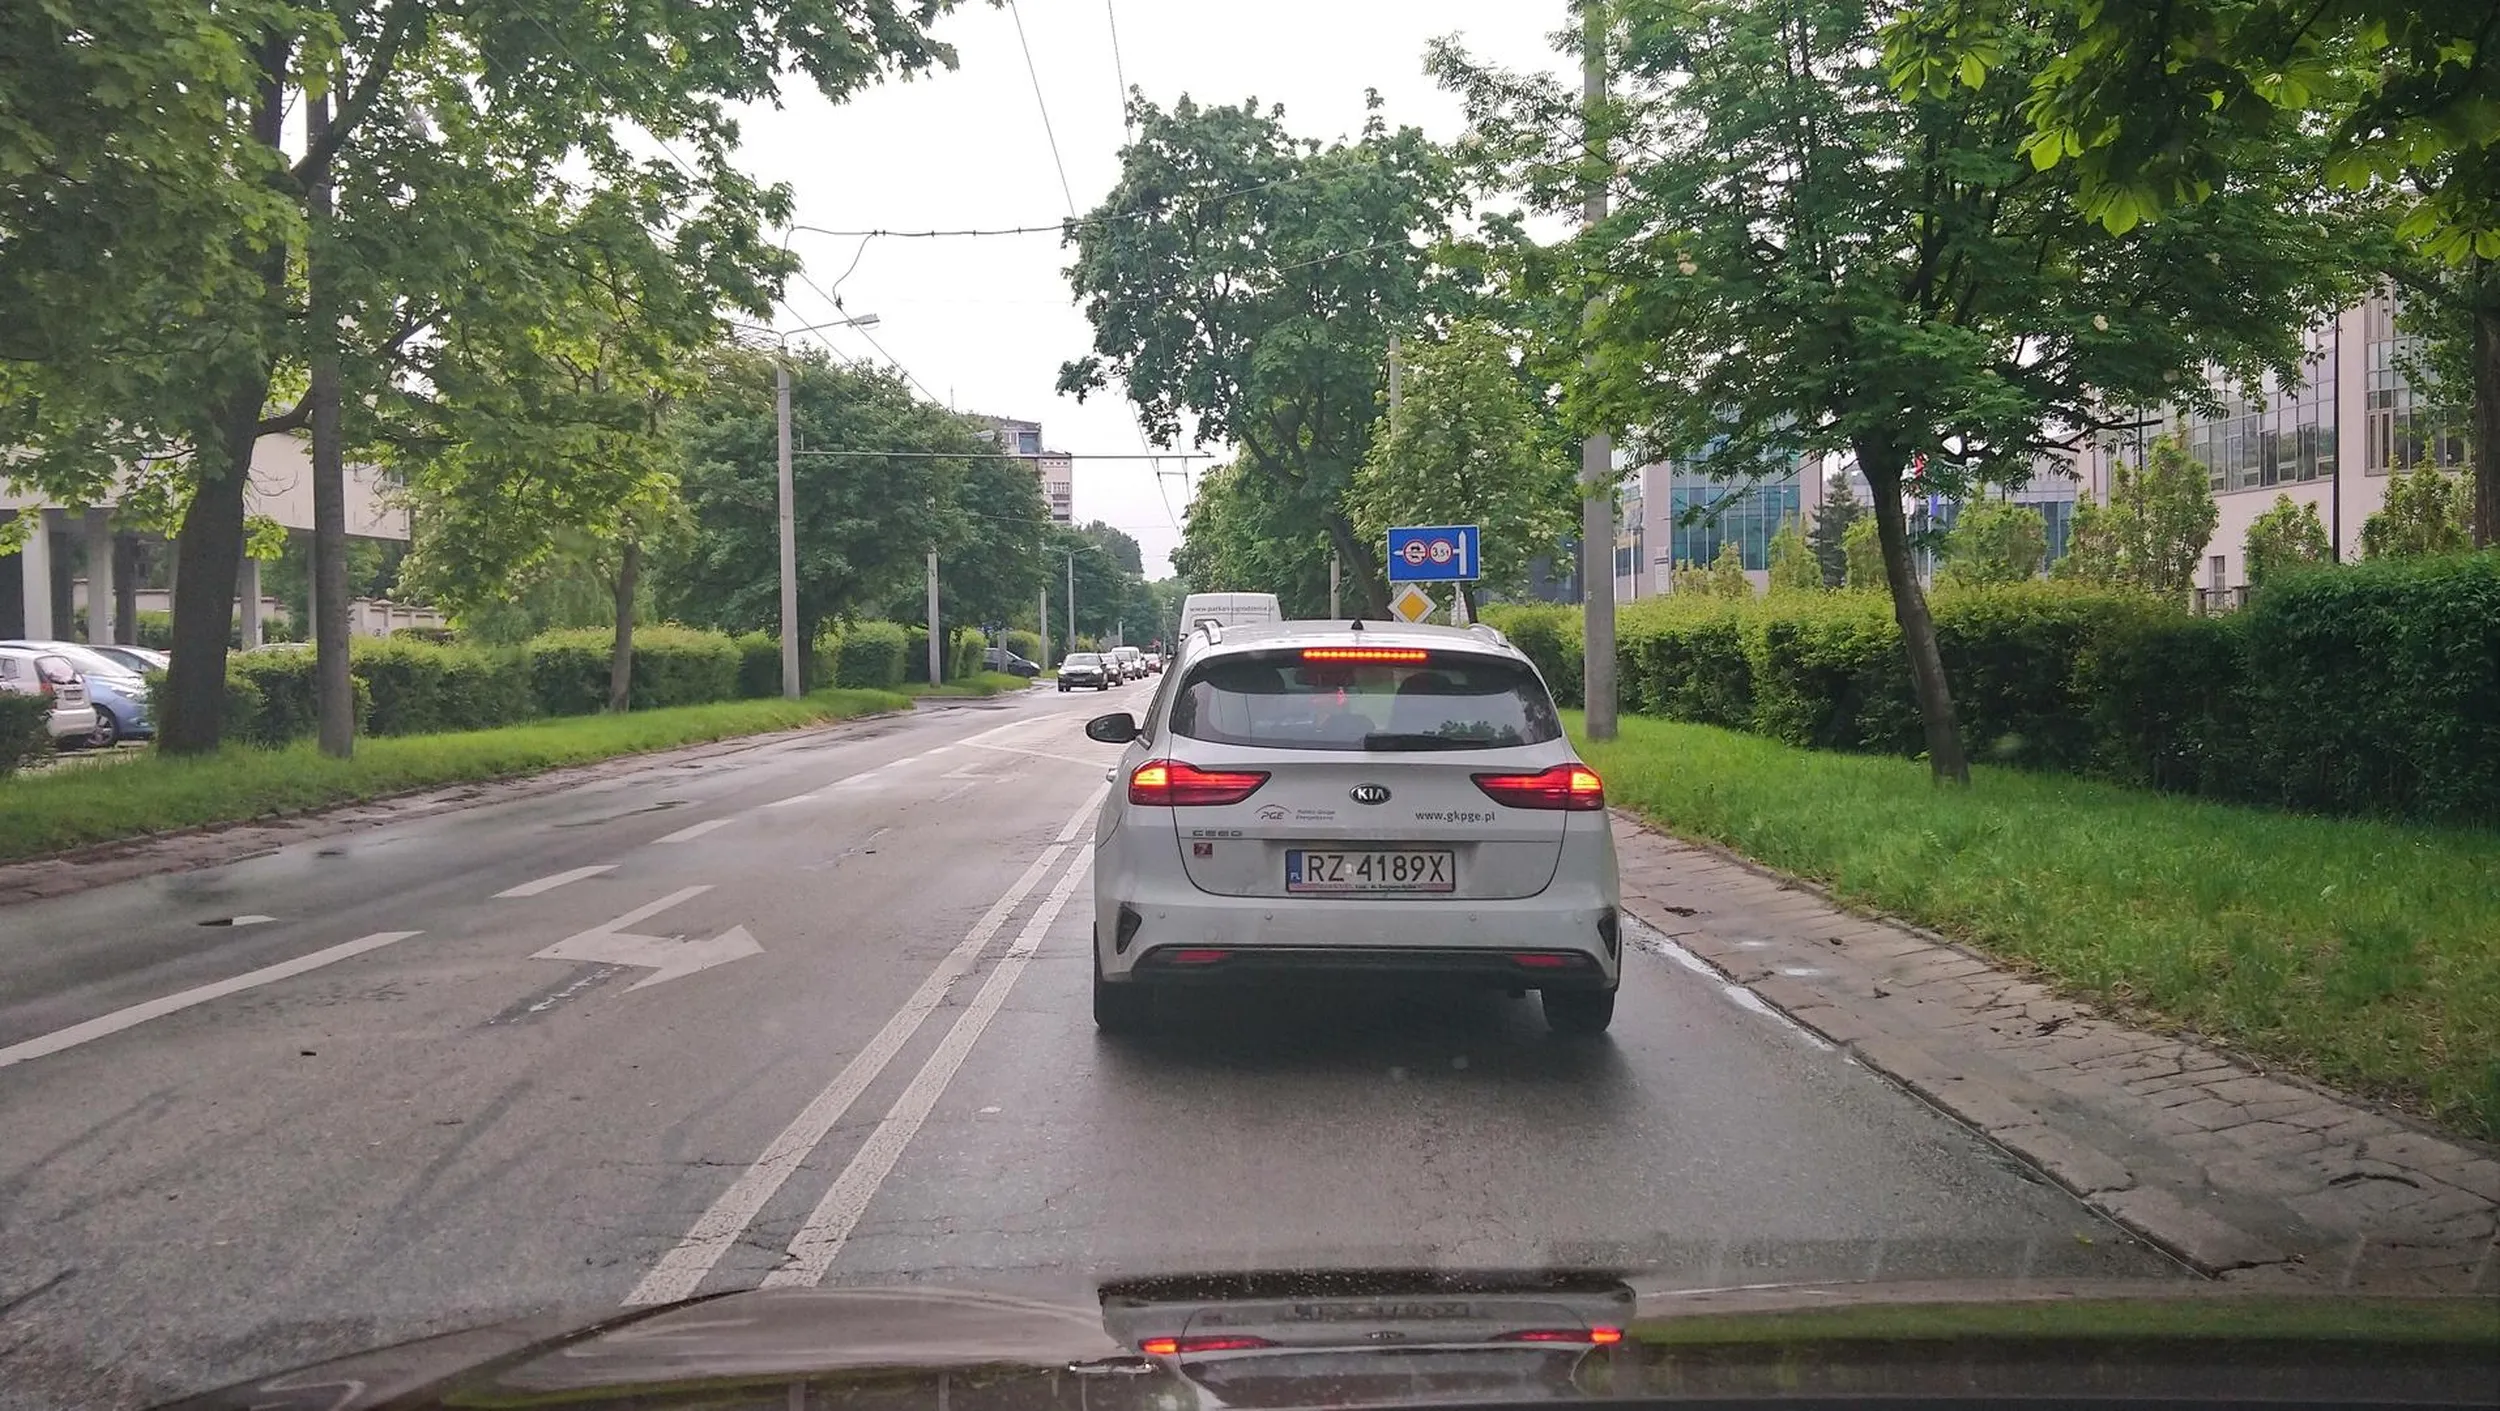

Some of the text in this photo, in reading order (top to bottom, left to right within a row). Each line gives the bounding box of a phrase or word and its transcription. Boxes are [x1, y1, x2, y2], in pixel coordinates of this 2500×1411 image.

[1357, 787, 1385, 800] KIA
[1260, 811, 1285, 820] PGE
[1415, 811, 1496, 823] www.gkpge.pl
[1308, 854, 1445, 882] RZ 4189X
[1290, 872, 1301, 880] PL
